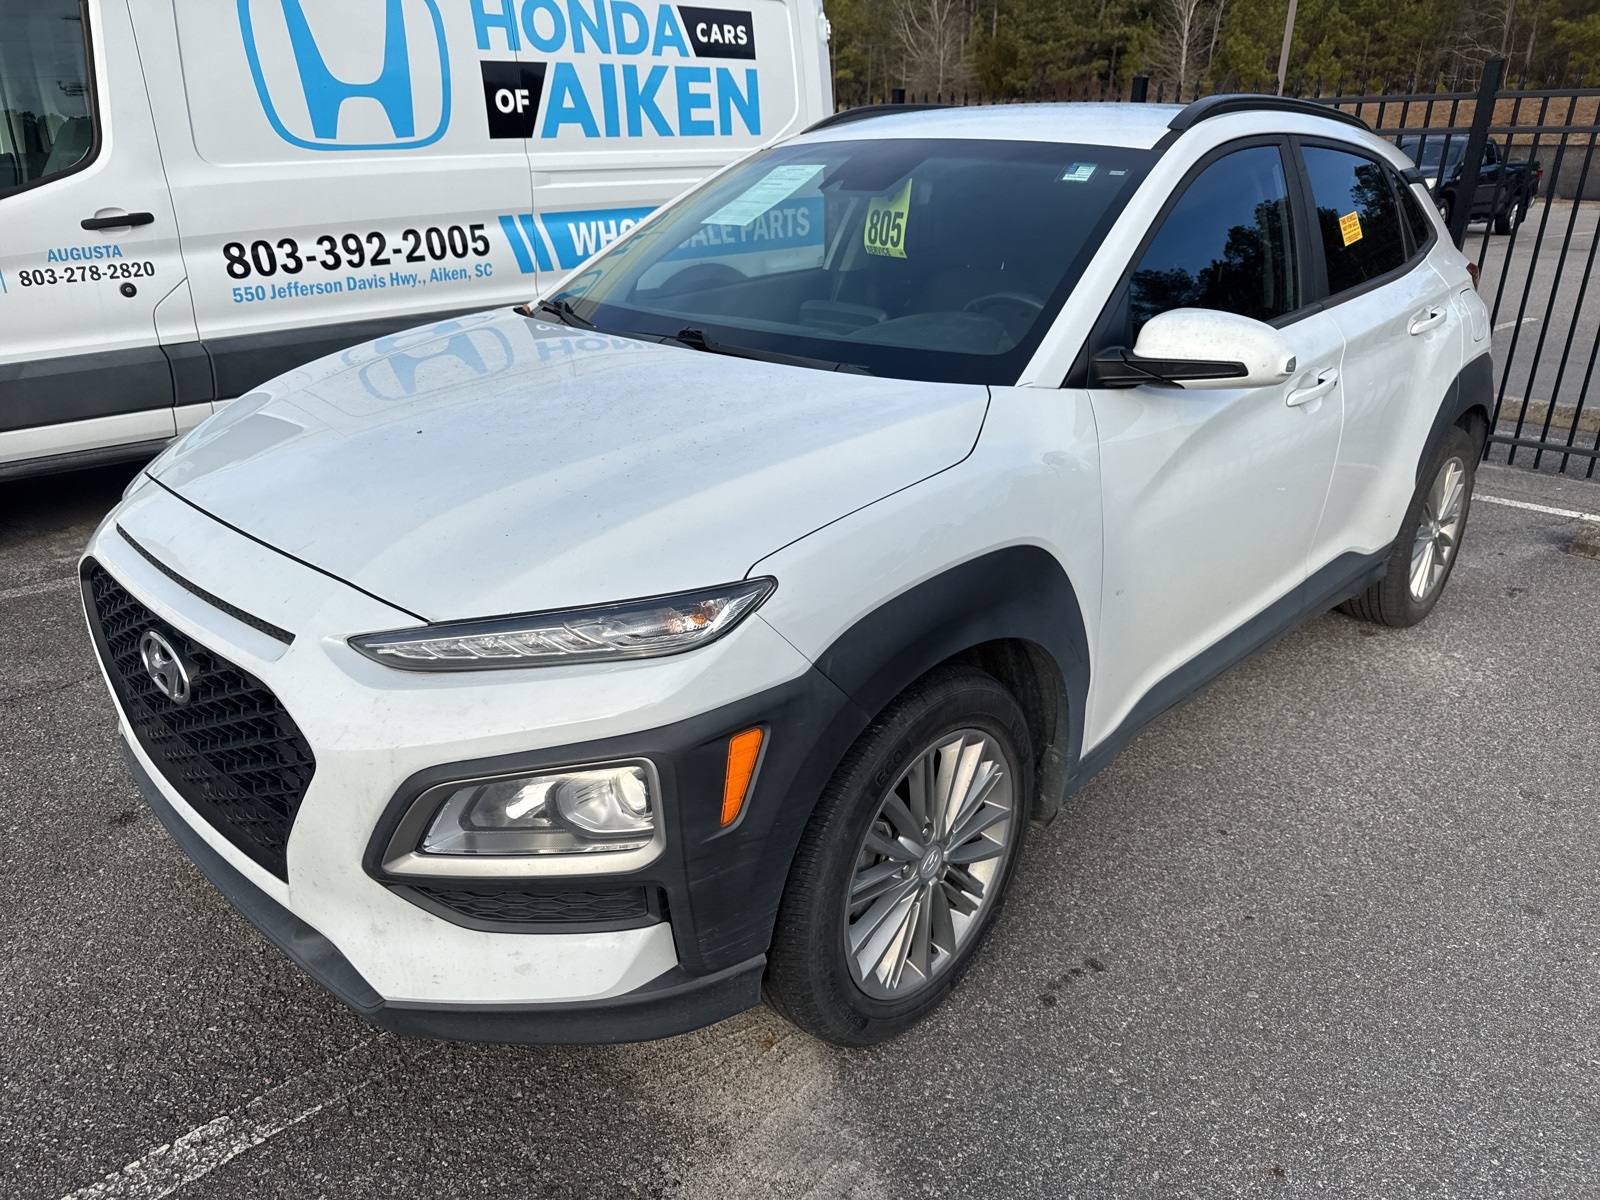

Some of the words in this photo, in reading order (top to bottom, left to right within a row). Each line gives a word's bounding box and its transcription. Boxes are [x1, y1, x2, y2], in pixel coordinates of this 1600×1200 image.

[470, 0, 690, 58] HONDA
[696, 22, 748, 45] CARS
[495, 88, 530, 114] OF
[541, 62, 761, 138] AIKEN
[868, 209, 904, 248] 805
[47, 244, 123, 263] AUGUSTA
[222, 223, 490, 280] 803-392-2005
[18, 261, 155, 287] 803-278-2820
[232, 286, 266, 303] 550
[270, 280, 343, 301] Jefferson
[346, 273, 386, 292] Davis
[390, 270, 426, 287] Hwy.,
[430, 265, 472, 283] Aiken,
[475, 262, 493, 278] SC
